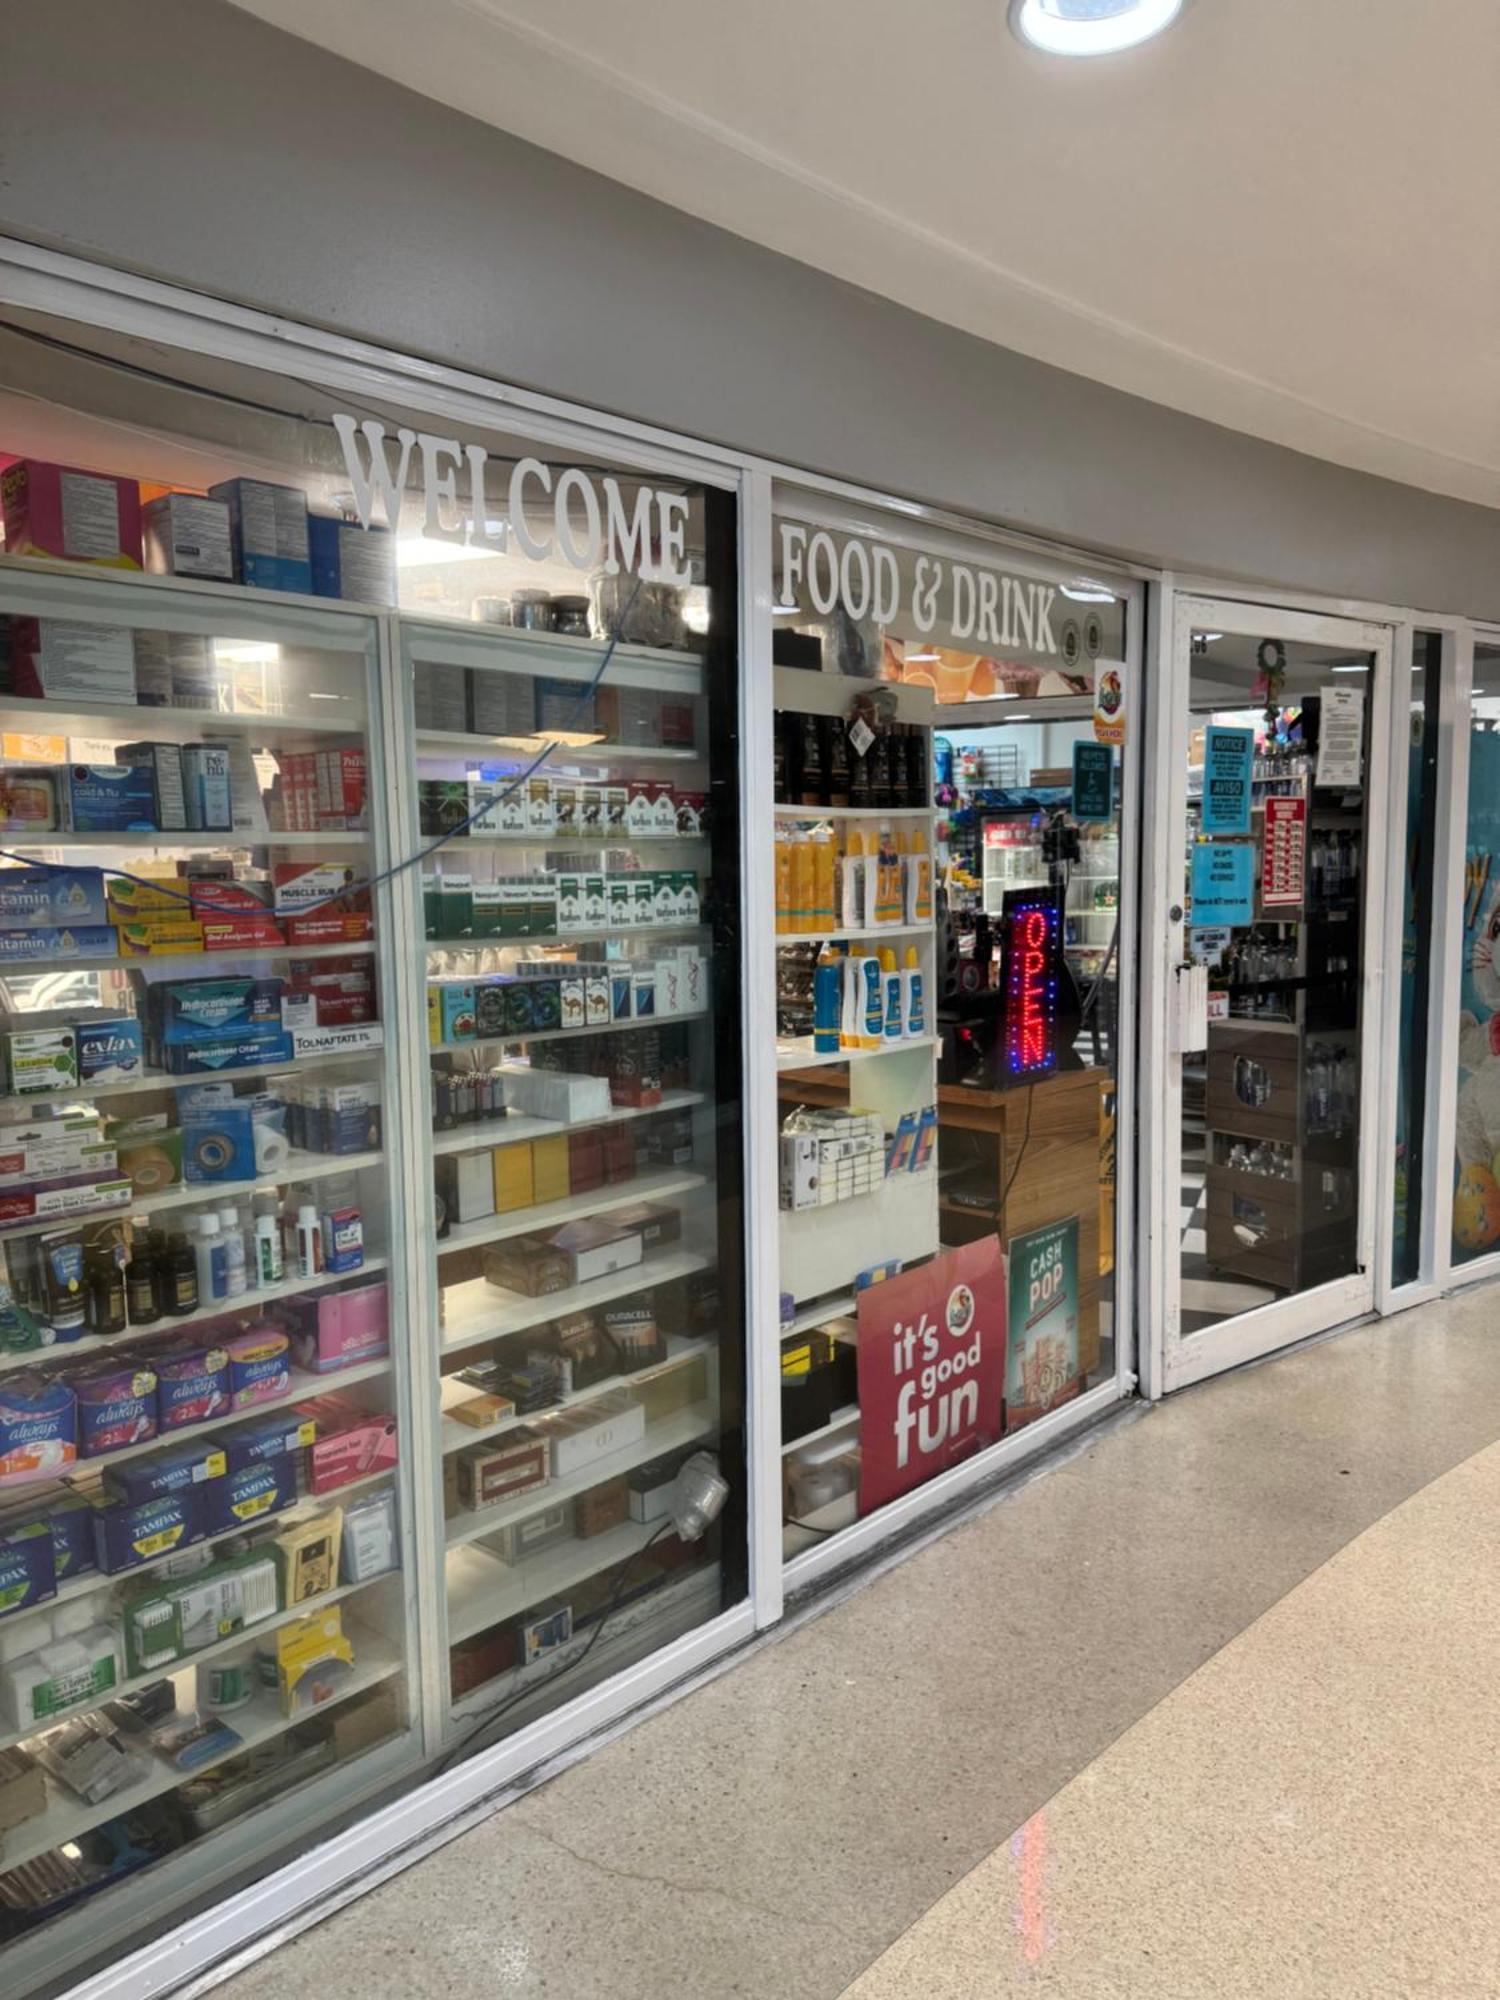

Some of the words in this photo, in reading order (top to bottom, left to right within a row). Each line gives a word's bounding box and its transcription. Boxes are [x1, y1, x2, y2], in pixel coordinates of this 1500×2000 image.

[332, 413, 692, 586] WELCOME
[780, 523, 900, 625] FOOD
[912, 556, 943, 632] &
[950, 565, 1058, 654] DRINK
[1214, 738, 1245, 751] NOTICE
[281, 888, 316, 897] MUSCLE
[1023, 911, 1045, 1065] OPEN
[296, 1034, 357, 1049] TOLNAFTATE
[1030, 1238, 1063, 1280] CASH
[1030, 1262, 1063, 1312] POP
[606, 1310, 653, 1322] DURACELL
[893, 1313, 940, 1376] it's
[920, 1330, 981, 1400] good
[172, 1380, 218, 1399] always
[96, 1403, 145, 1425] always
[893, 1378, 979, 1470] fun
[9, 1420, 60, 1441] always
[151, 1468, 190, 1489] TAMPAX
[231, 1475, 277, 1501] TAMPAX
[133, 1510, 183, 1538] TAMPAX
